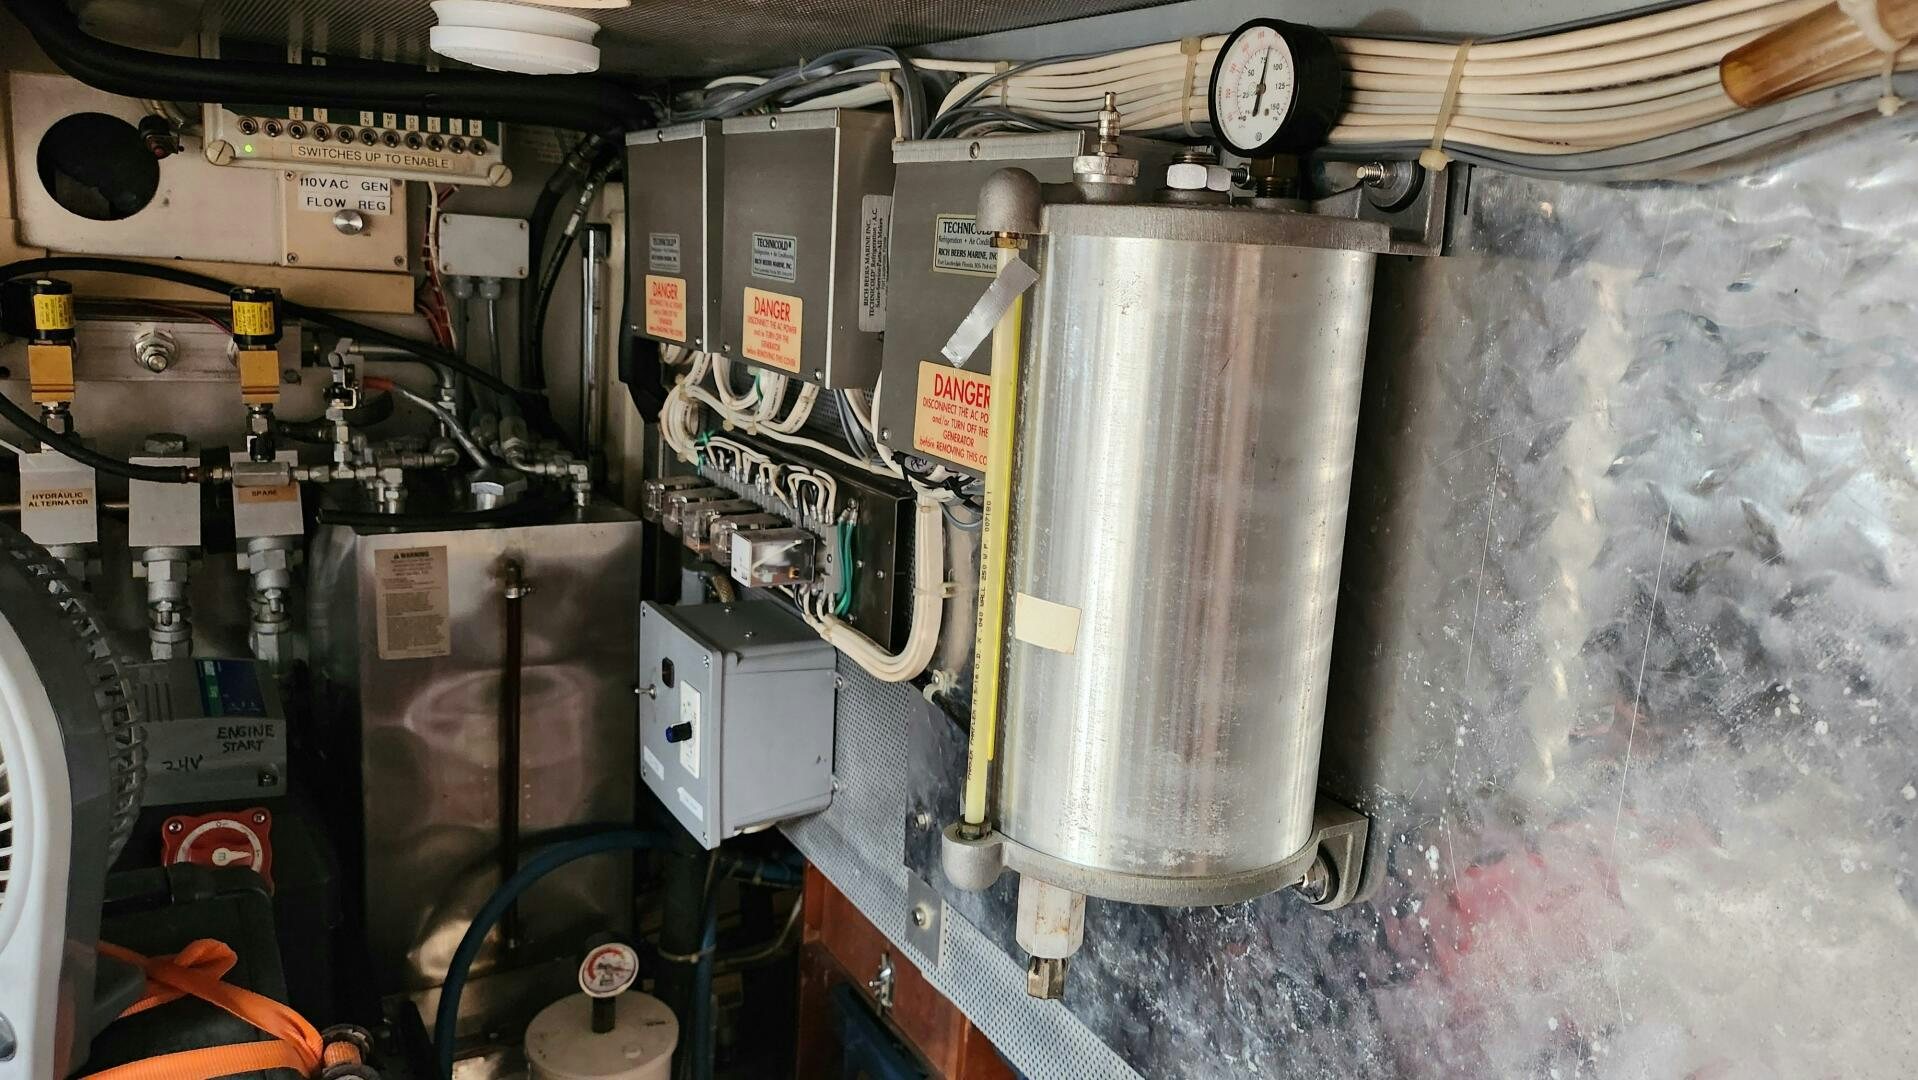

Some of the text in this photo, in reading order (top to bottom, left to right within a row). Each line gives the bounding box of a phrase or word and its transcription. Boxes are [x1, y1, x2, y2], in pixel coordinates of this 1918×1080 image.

[1273, 63, 1282, 71] 100
[1276, 81, 1285, 90] 125
[1270, 103, 1280, 111] 150
[298, 146, 449, 169] SWITCHES UP TO ENABLE
[300, 177, 388, 192] 110VAC GEN
[306, 196, 386, 210] FLOW REG
[938, 248, 950, 256] RICH
[951, 249, 966, 258] BEERS
[653, 282, 678, 300] DANGER
[754, 296, 791, 322] DANGER
[934, 373, 990, 408] DANGER
[923, 397, 957, 416] DISCONNECT
[959, 406, 968, 418] THE
[970, 410, 979, 421] AC
[952, 418, 965, 432] TURN
[966, 422, 978, 434] OFF
[978, 426, 989, 438] THE
[943, 430, 975, 448] GENERATOR
[936, 440, 964, 459] REMOVING
[966, 450, 978, 463] THIS
[28, 498, 88, 508] ALTERNATOR
[32, 492, 83, 500] HYDRAULIC
[216, 724, 276, 740] ENGINE
[222, 740, 264, 754] START
